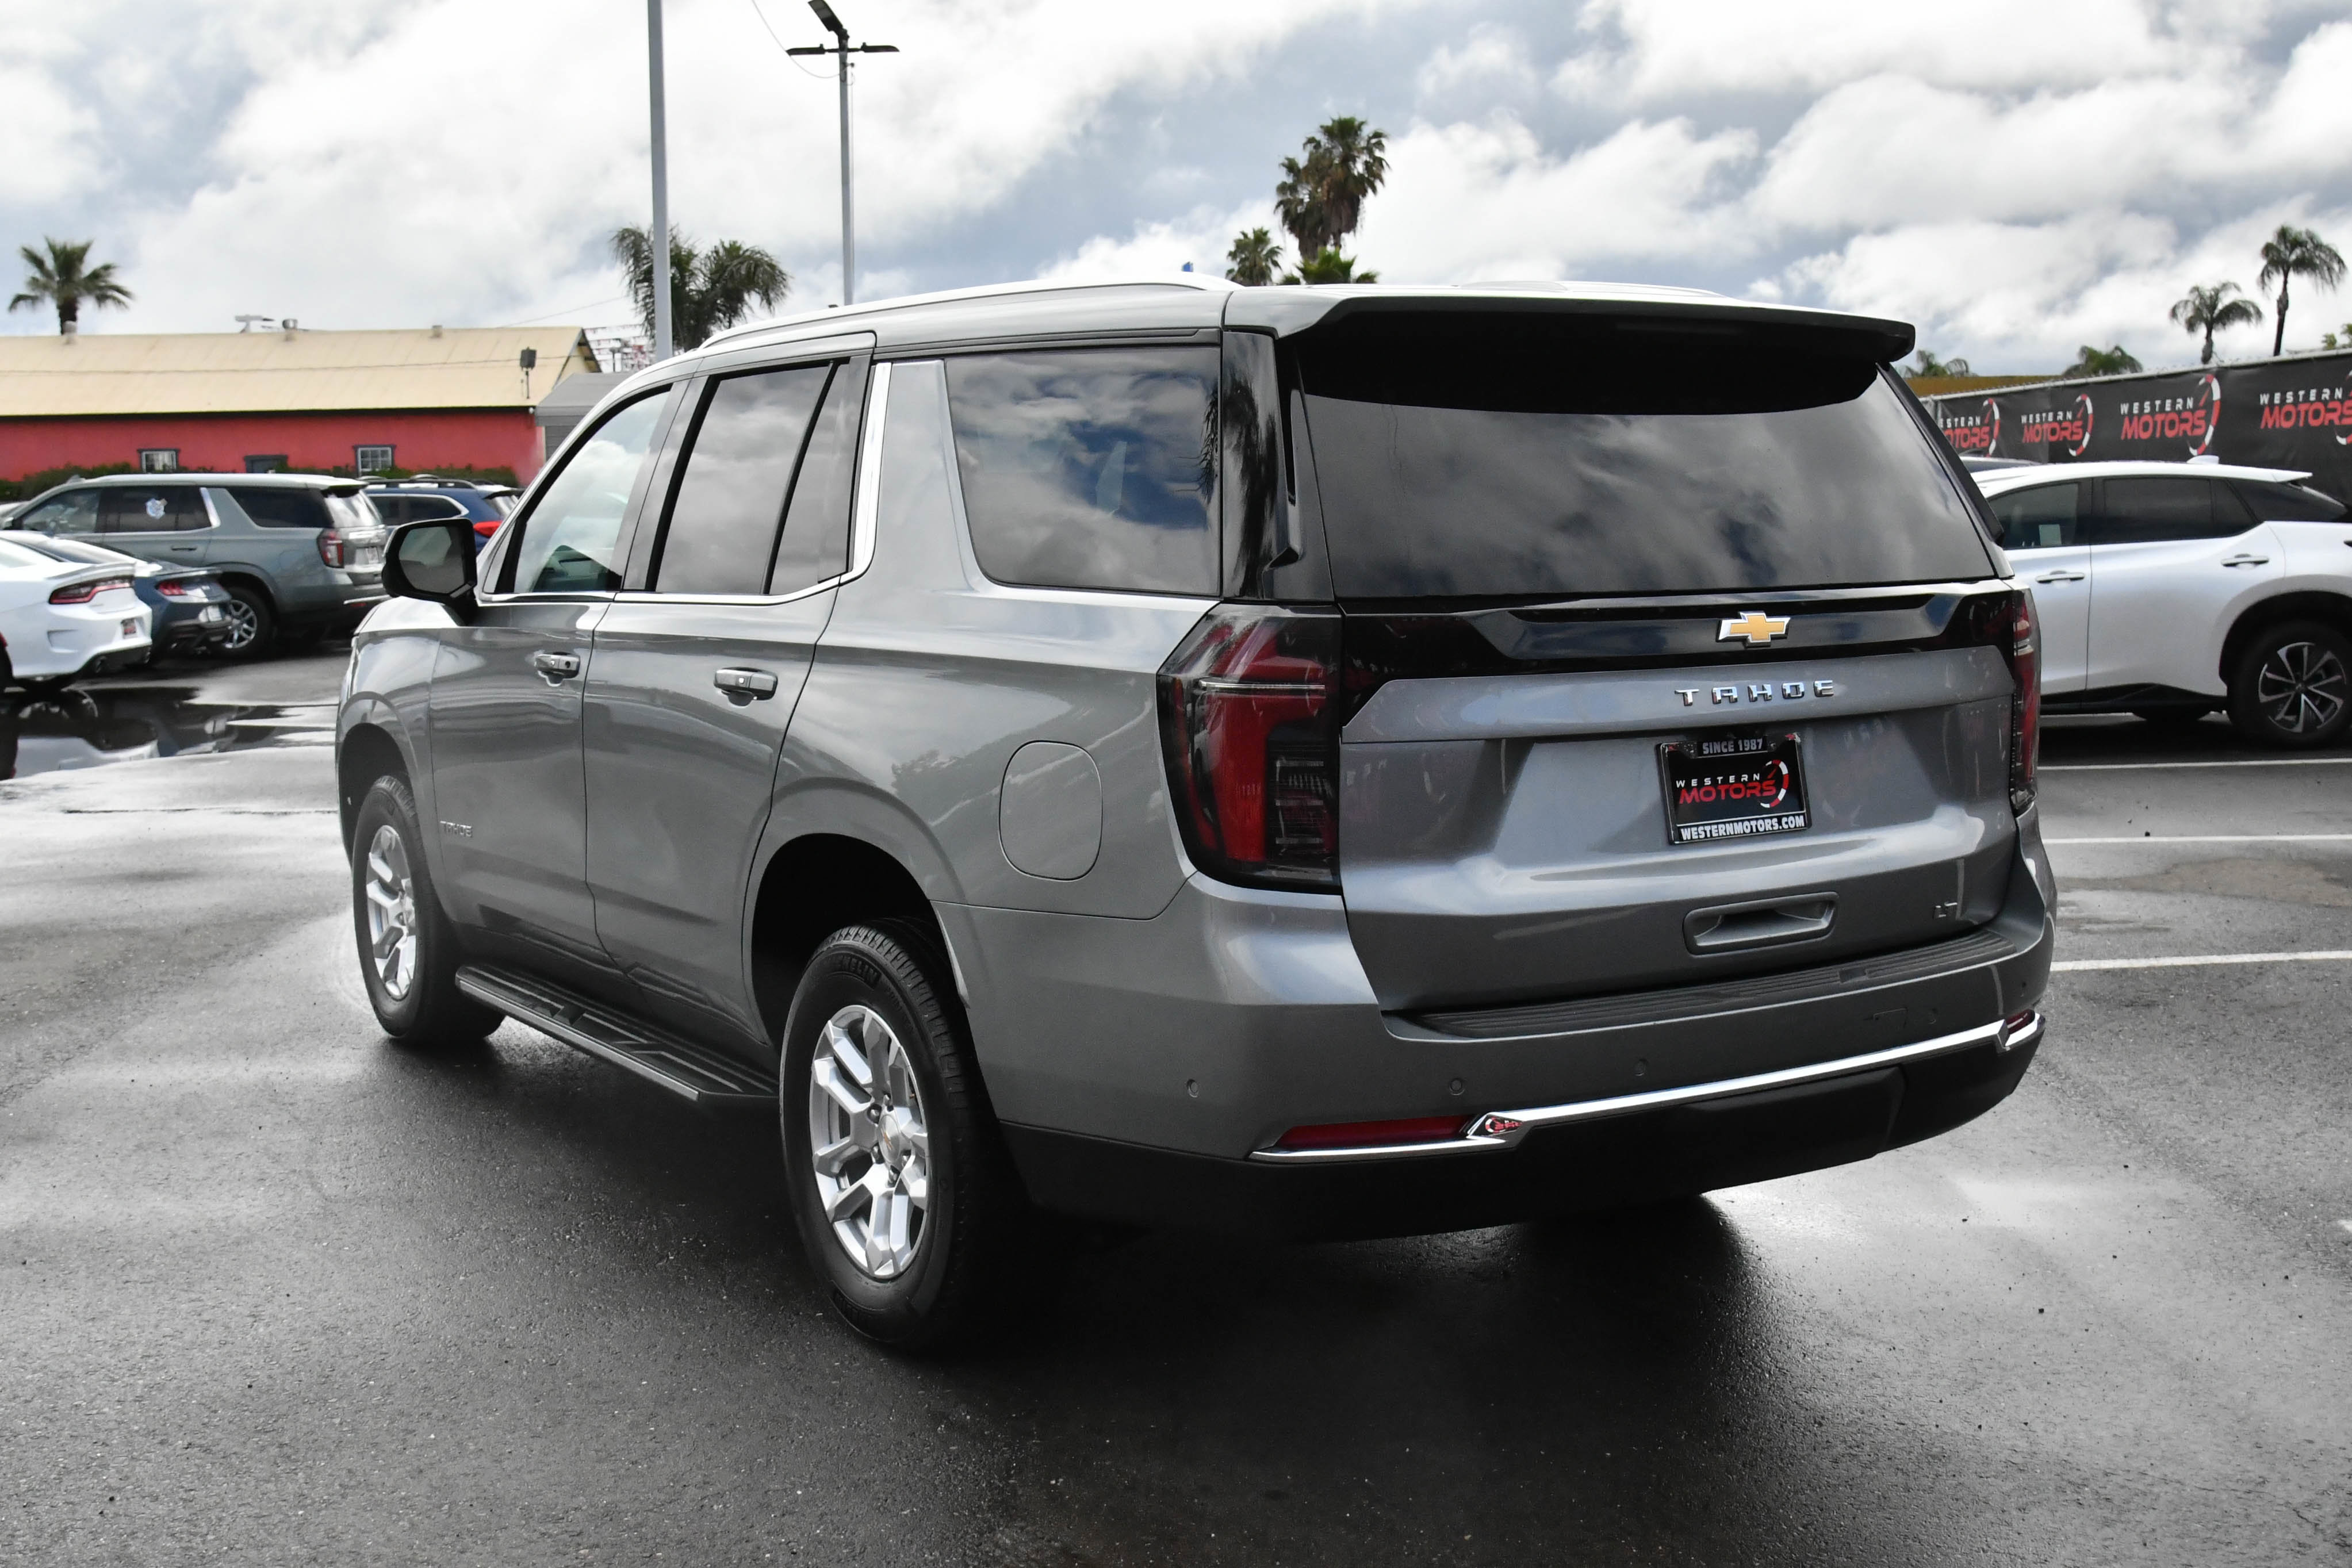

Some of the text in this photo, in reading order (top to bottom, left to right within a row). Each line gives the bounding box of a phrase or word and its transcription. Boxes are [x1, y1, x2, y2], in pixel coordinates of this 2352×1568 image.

[2120, 397, 2194, 415] WESTERN
[2260, 387, 2343, 405] WESTERN
[1937, 416, 1981, 428] ESTERN
[2021, 411, 2073, 424] WESTERN
[2121, 409, 2207, 440] MOTORS
[2260, 399, 2352, 430] MOTORS
[1944, 426, 1990, 448] OTORS
[2022, 420, 2083, 443] MOTORS
[1675, 679, 1834, 707] TAHOE
[1702, 738, 1763, 754] SINCE 1987
[1676, 773, 1760, 788] WESTERN
[1679, 780, 1776, 804] MOTORS
[440, 820, 472, 838] TAHOE
[1680, 815, 1805, 841] WESTERNMOTORS.COM
